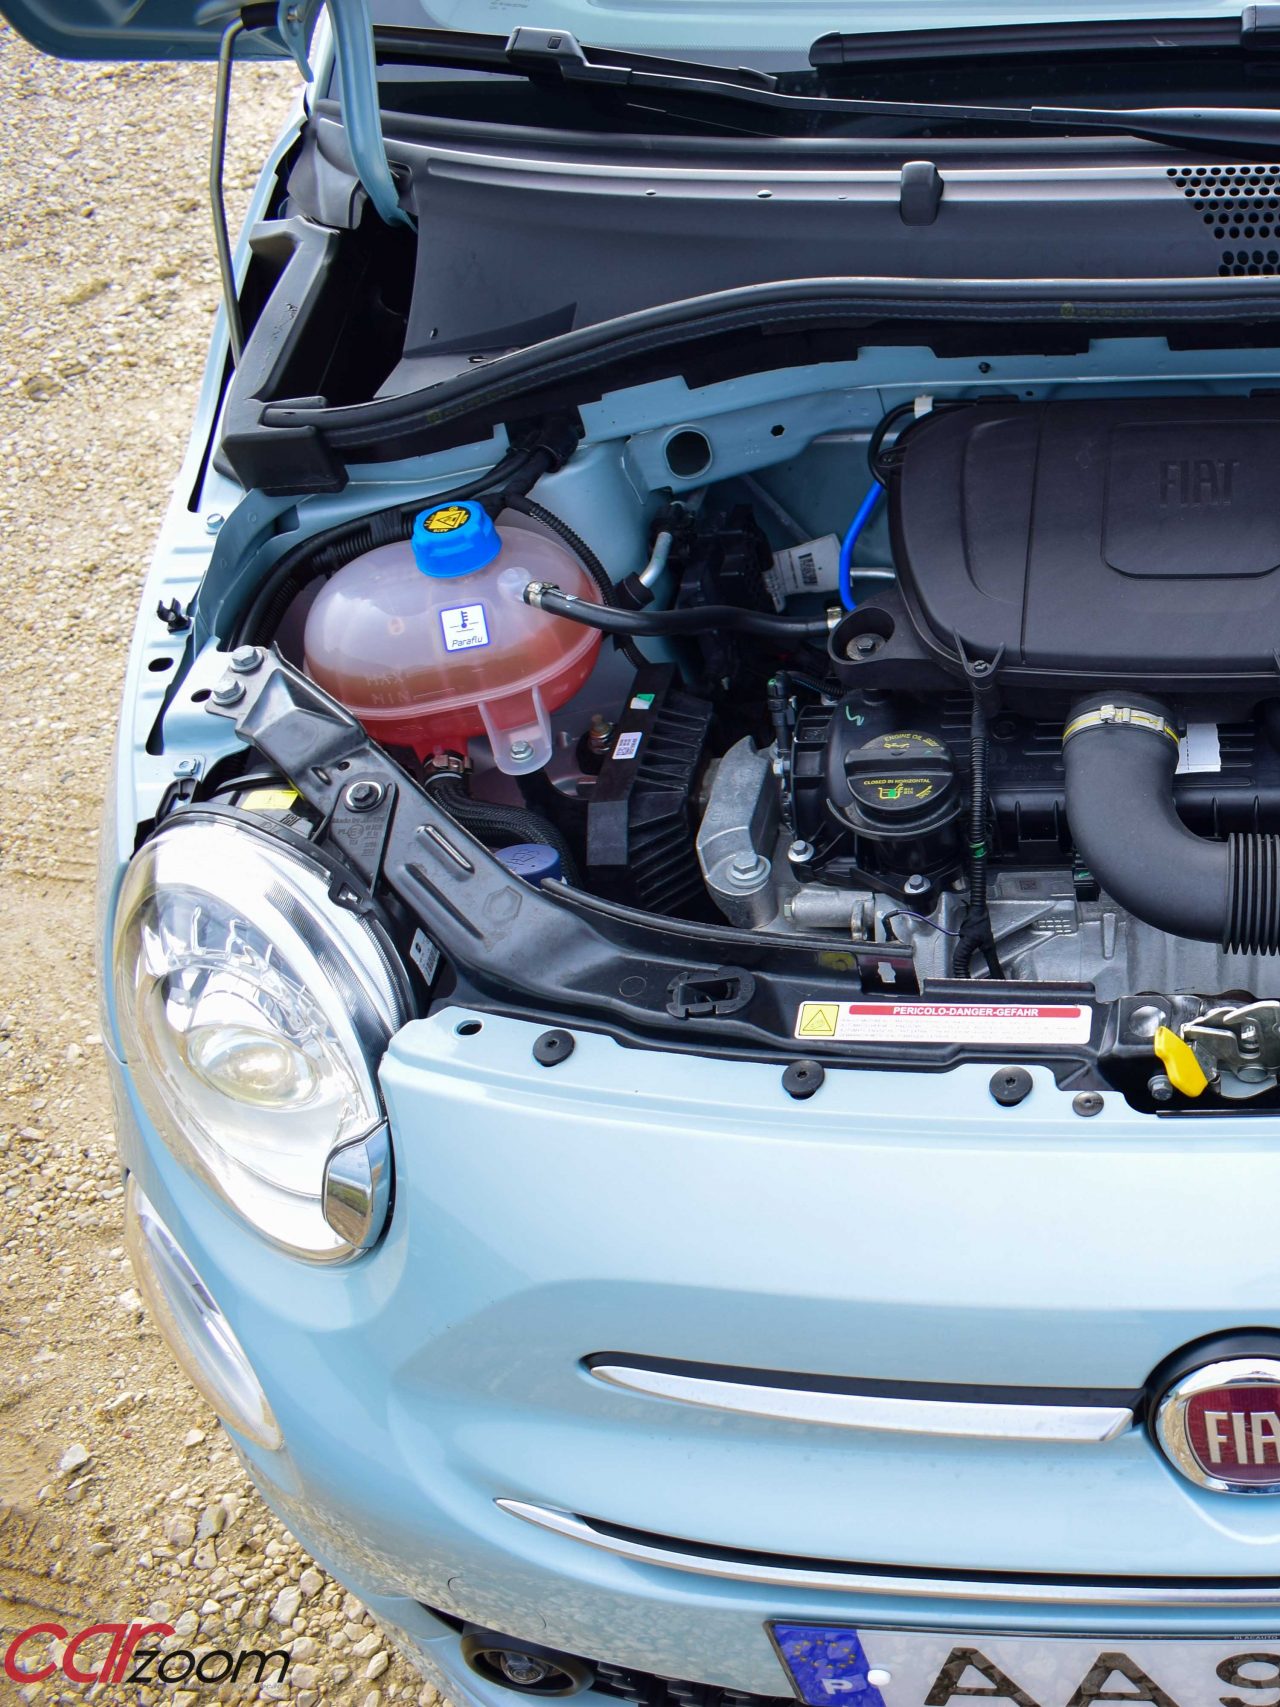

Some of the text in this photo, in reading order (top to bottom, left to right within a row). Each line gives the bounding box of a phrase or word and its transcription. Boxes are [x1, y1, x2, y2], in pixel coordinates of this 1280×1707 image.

[1159, 459, 1240, 506] FIAT
[451, 635, 483, 648] Paraflu
[366, 672, 404, 687] MAX
[371, 689, 411, 705] MIN
[883, 733, 912, 742] ENGINE
[892, 1005, 1039, 1018] PERICOLO-DANGER-GEFAHR
[821, 1677, 853, 1695] P
